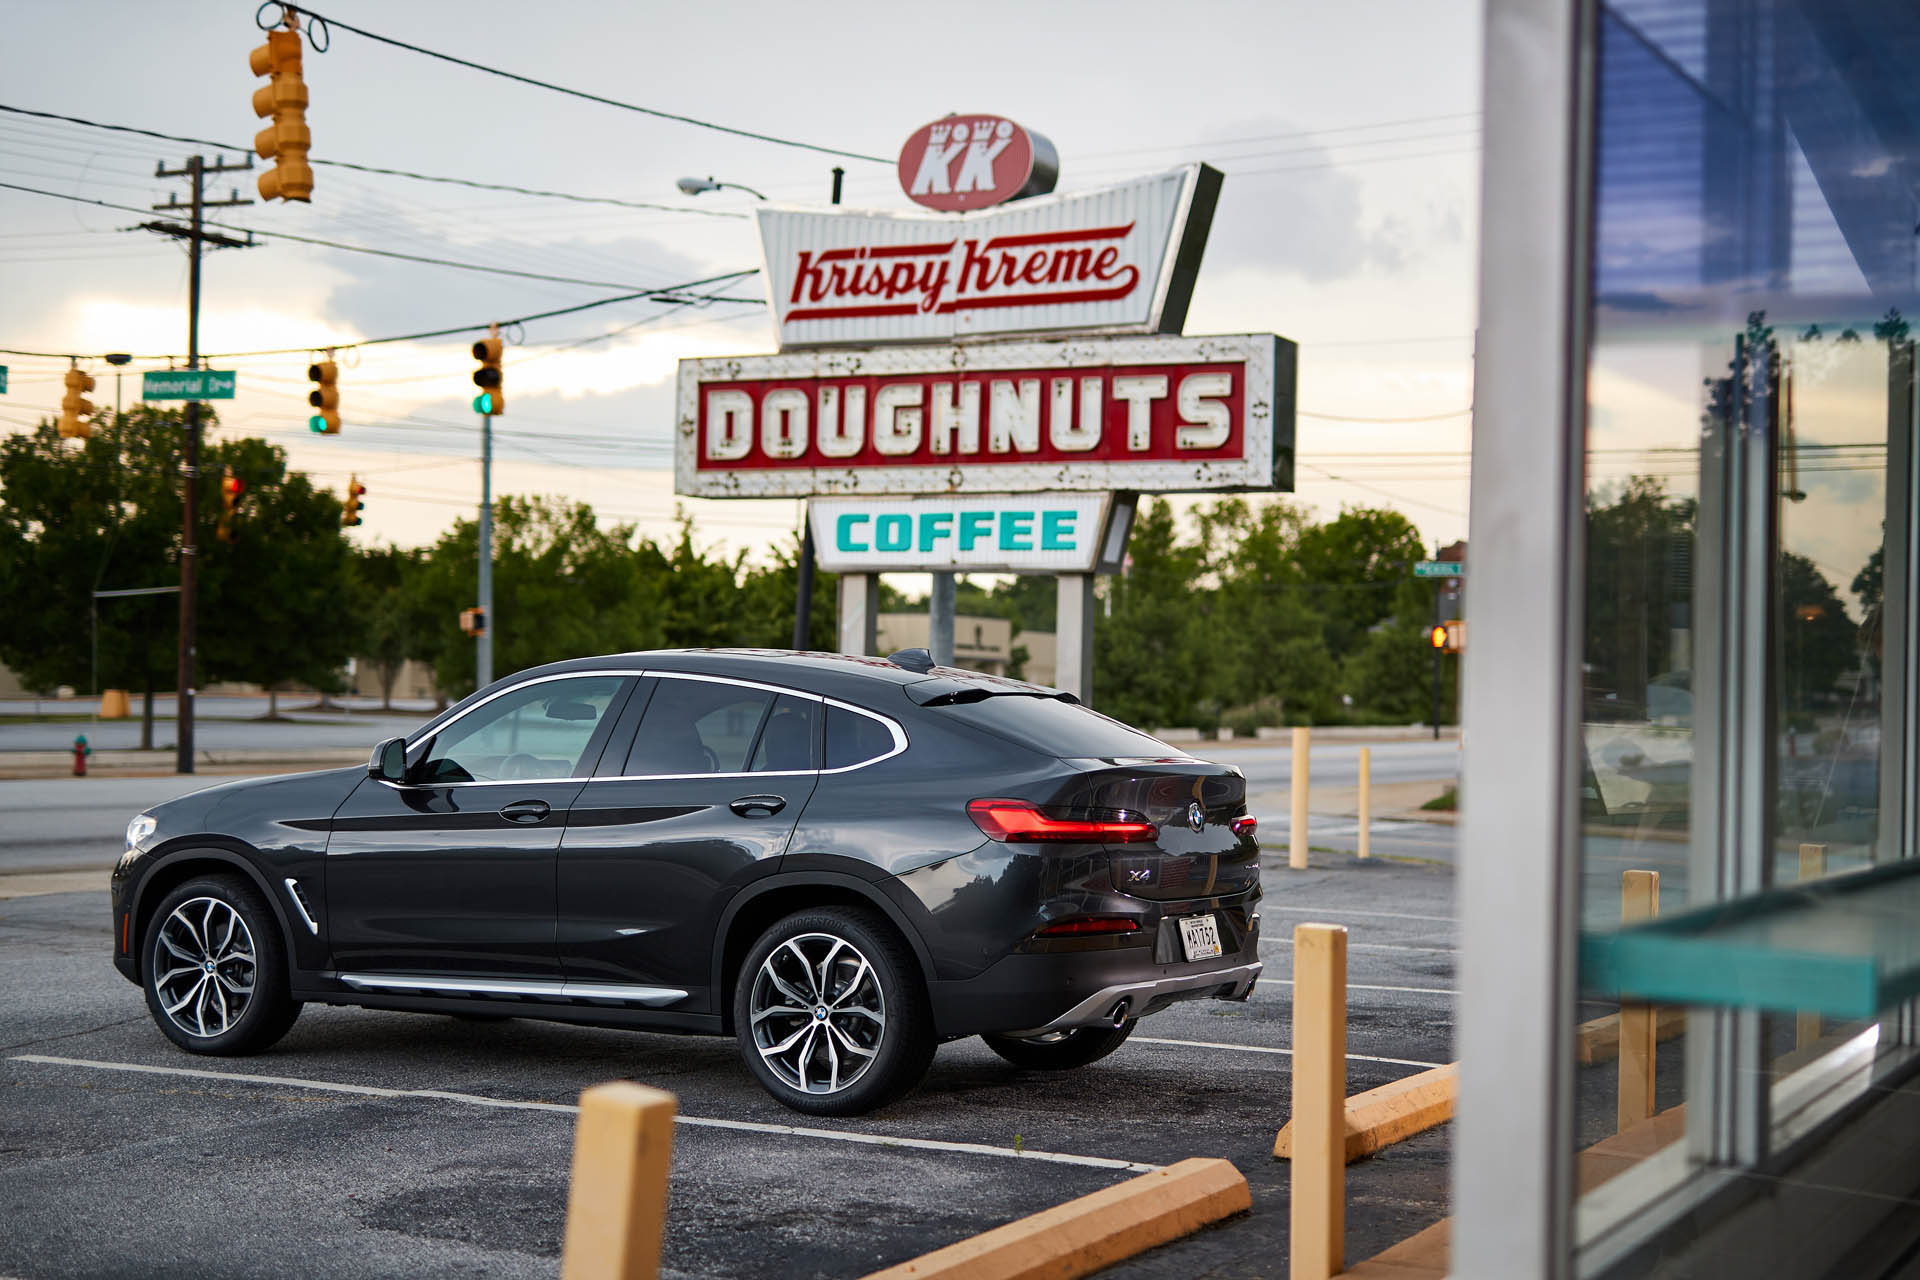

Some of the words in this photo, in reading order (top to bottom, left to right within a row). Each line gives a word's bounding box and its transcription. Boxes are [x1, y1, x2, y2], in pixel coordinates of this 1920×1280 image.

[909, 137, 1013, 196] KK
[786, 243, 956, 314] Krispy
[956, 227, 1138, 299] Kreme
[704, 371, 1235, 462] DOUGHNUTS
[835, 510, 1079, 553] COFFEE
[1127, 869, 1151, 882] X4
